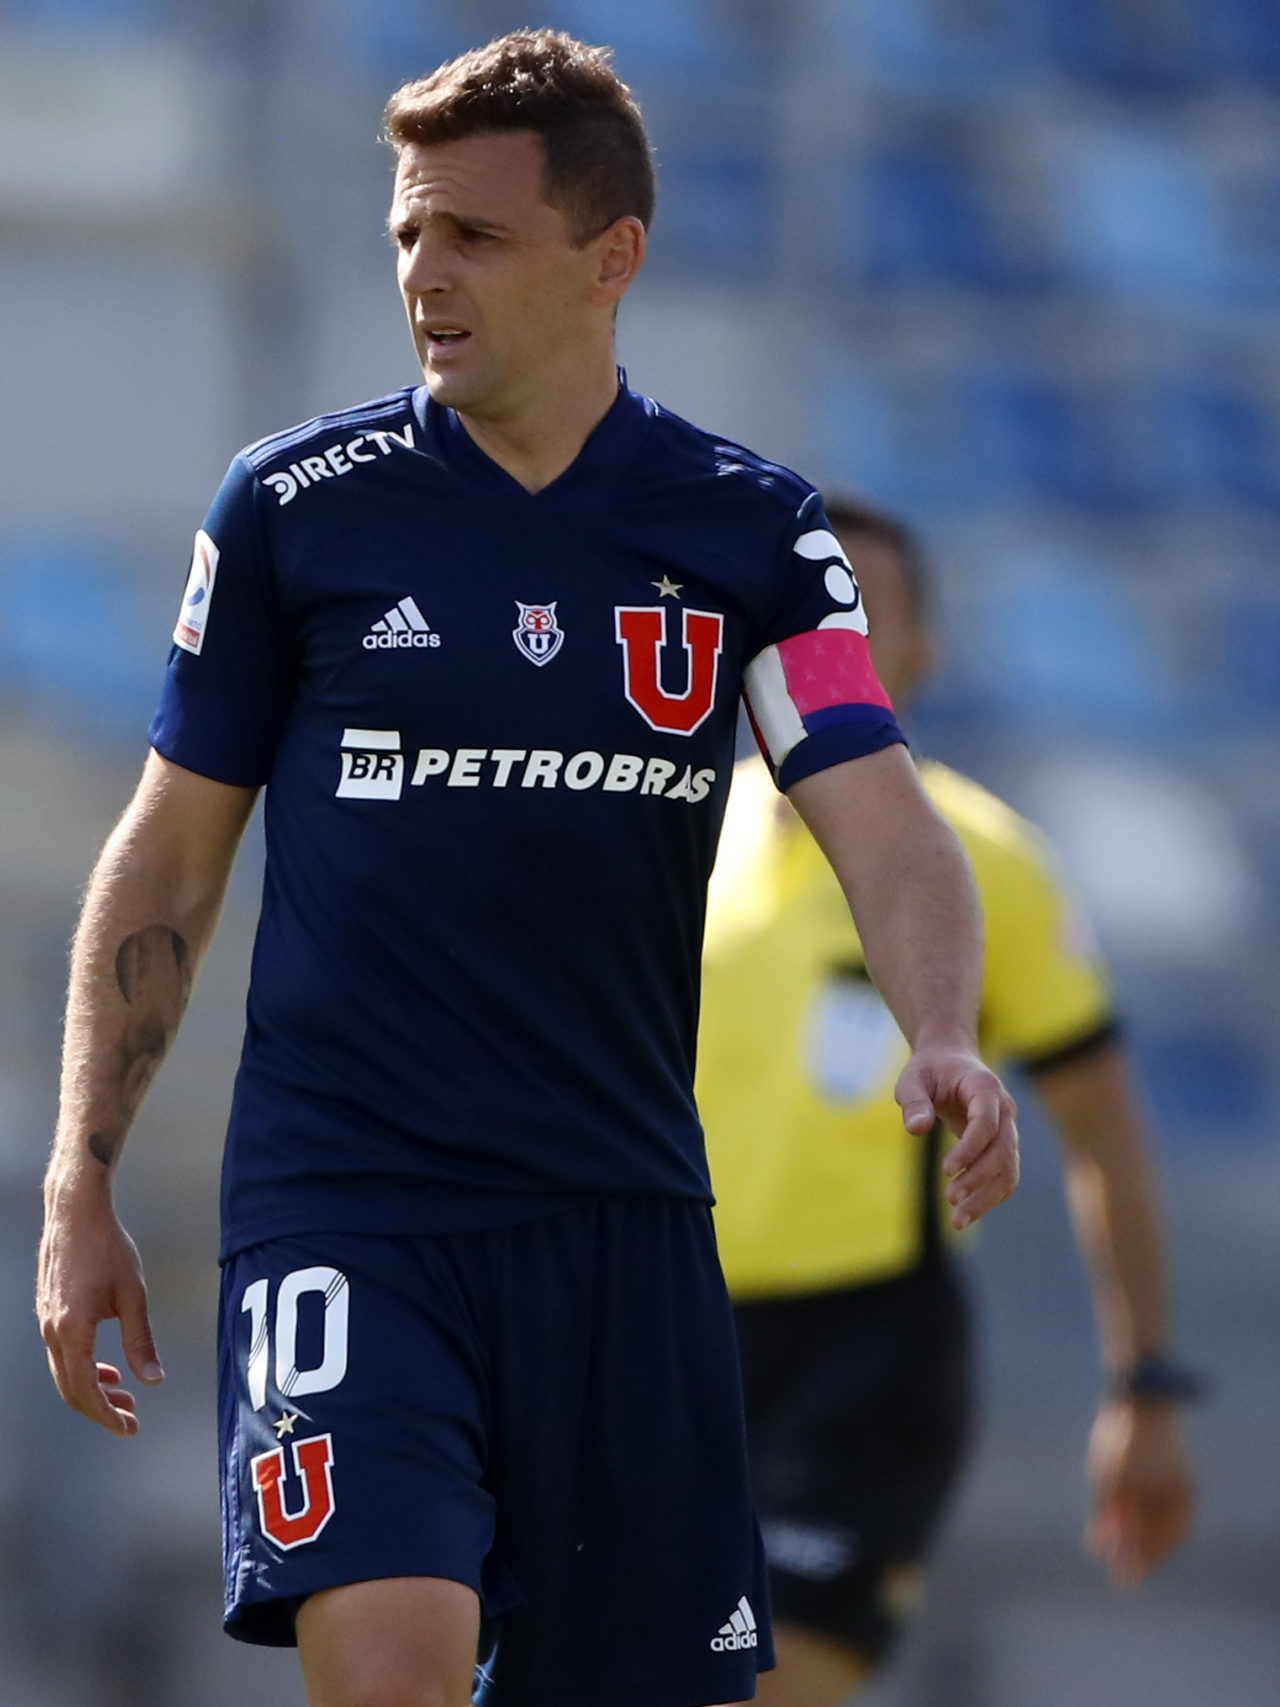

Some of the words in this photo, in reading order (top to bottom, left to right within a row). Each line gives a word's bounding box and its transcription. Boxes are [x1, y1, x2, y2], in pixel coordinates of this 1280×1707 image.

[262, 423, 415, 506] DIRECTV
[362, 629, 441, 650] adidas
[527, 633, 551, 655] U
[615, 605, 724, 737] U
[347, 755, 397, 782] BR
[410, 748, 716, 804] PETROBRAS
[241, 1266, 350, 1412] 10
[250, 1433, 335, 1551] U
[710, 1630, 758, 1652] adida
